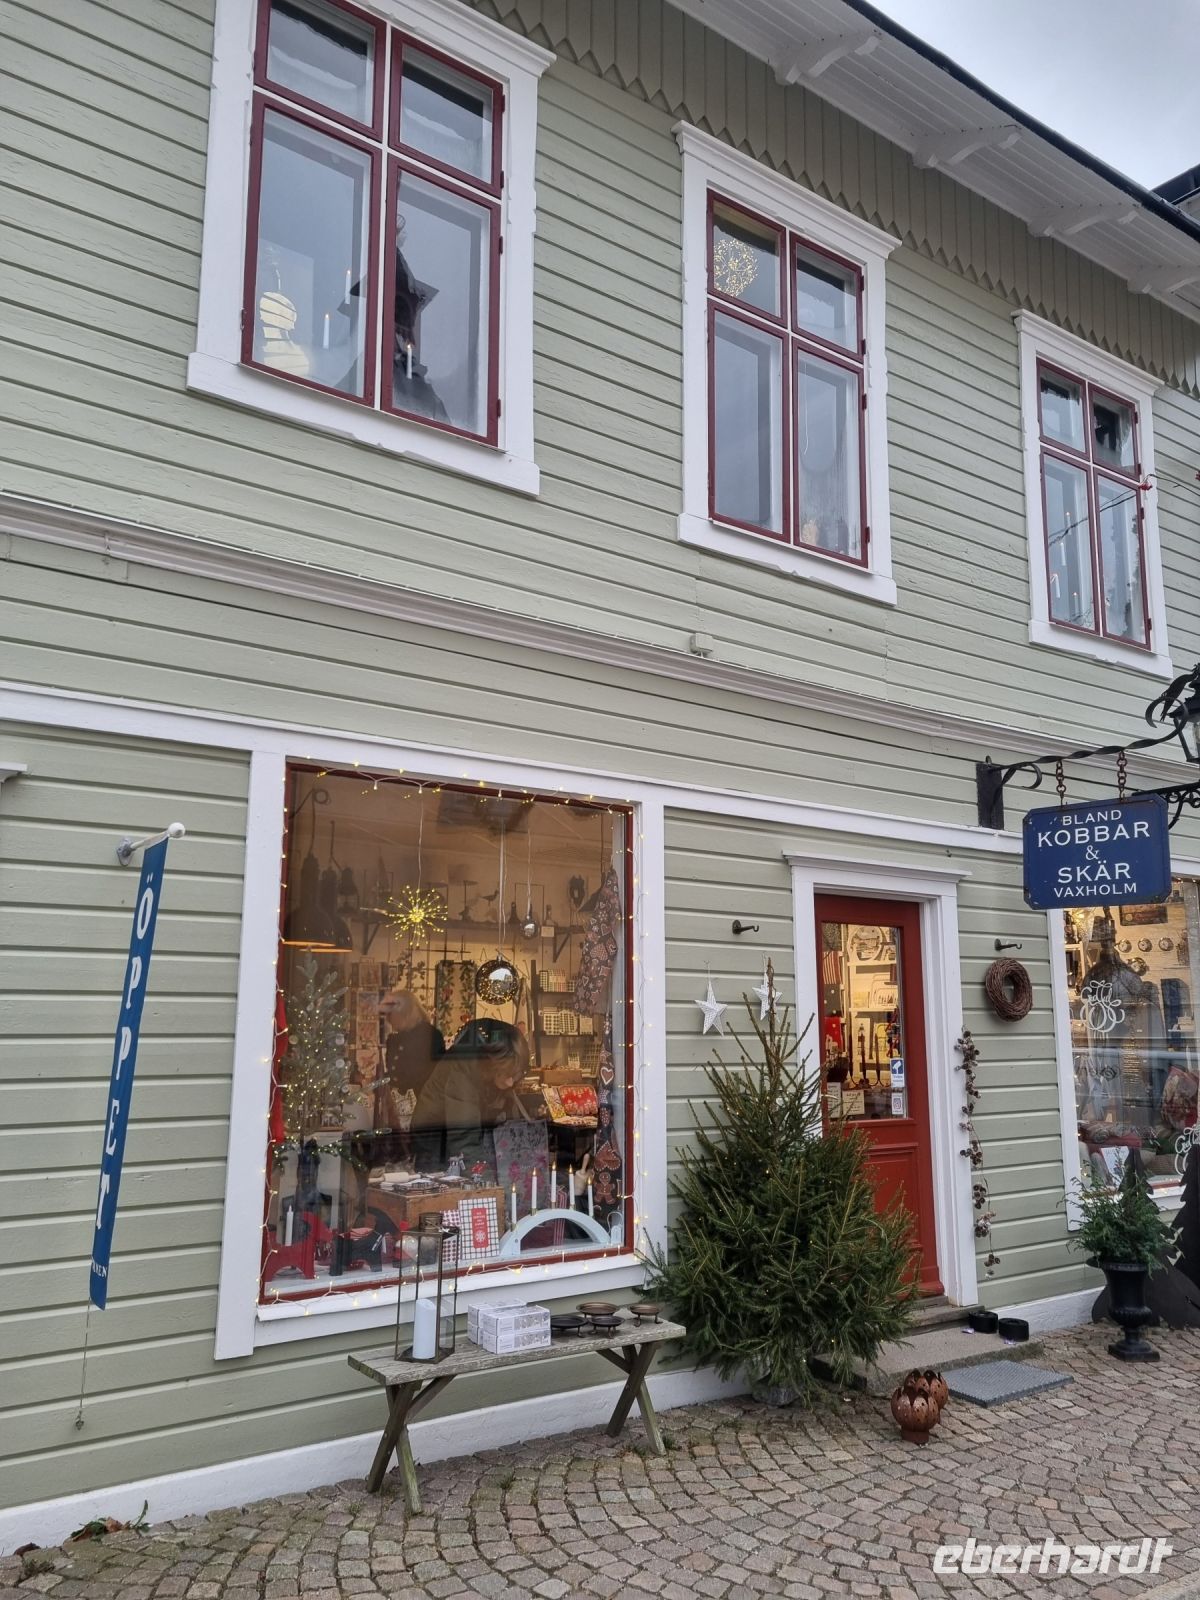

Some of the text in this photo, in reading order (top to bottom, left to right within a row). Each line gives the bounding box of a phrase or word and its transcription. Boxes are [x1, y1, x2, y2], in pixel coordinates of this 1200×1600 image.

[1062, 810, 1121, 825] BLAND
[1038, 821, 1149, 847] KOBBAR
[1085, 845, 1100, 861] &
[1058, 860, 1131, 883] SKÄR
[1054, 883, 1136, 897] VAXHOLM
[96, 872, 155, 1231] ÖPPET
